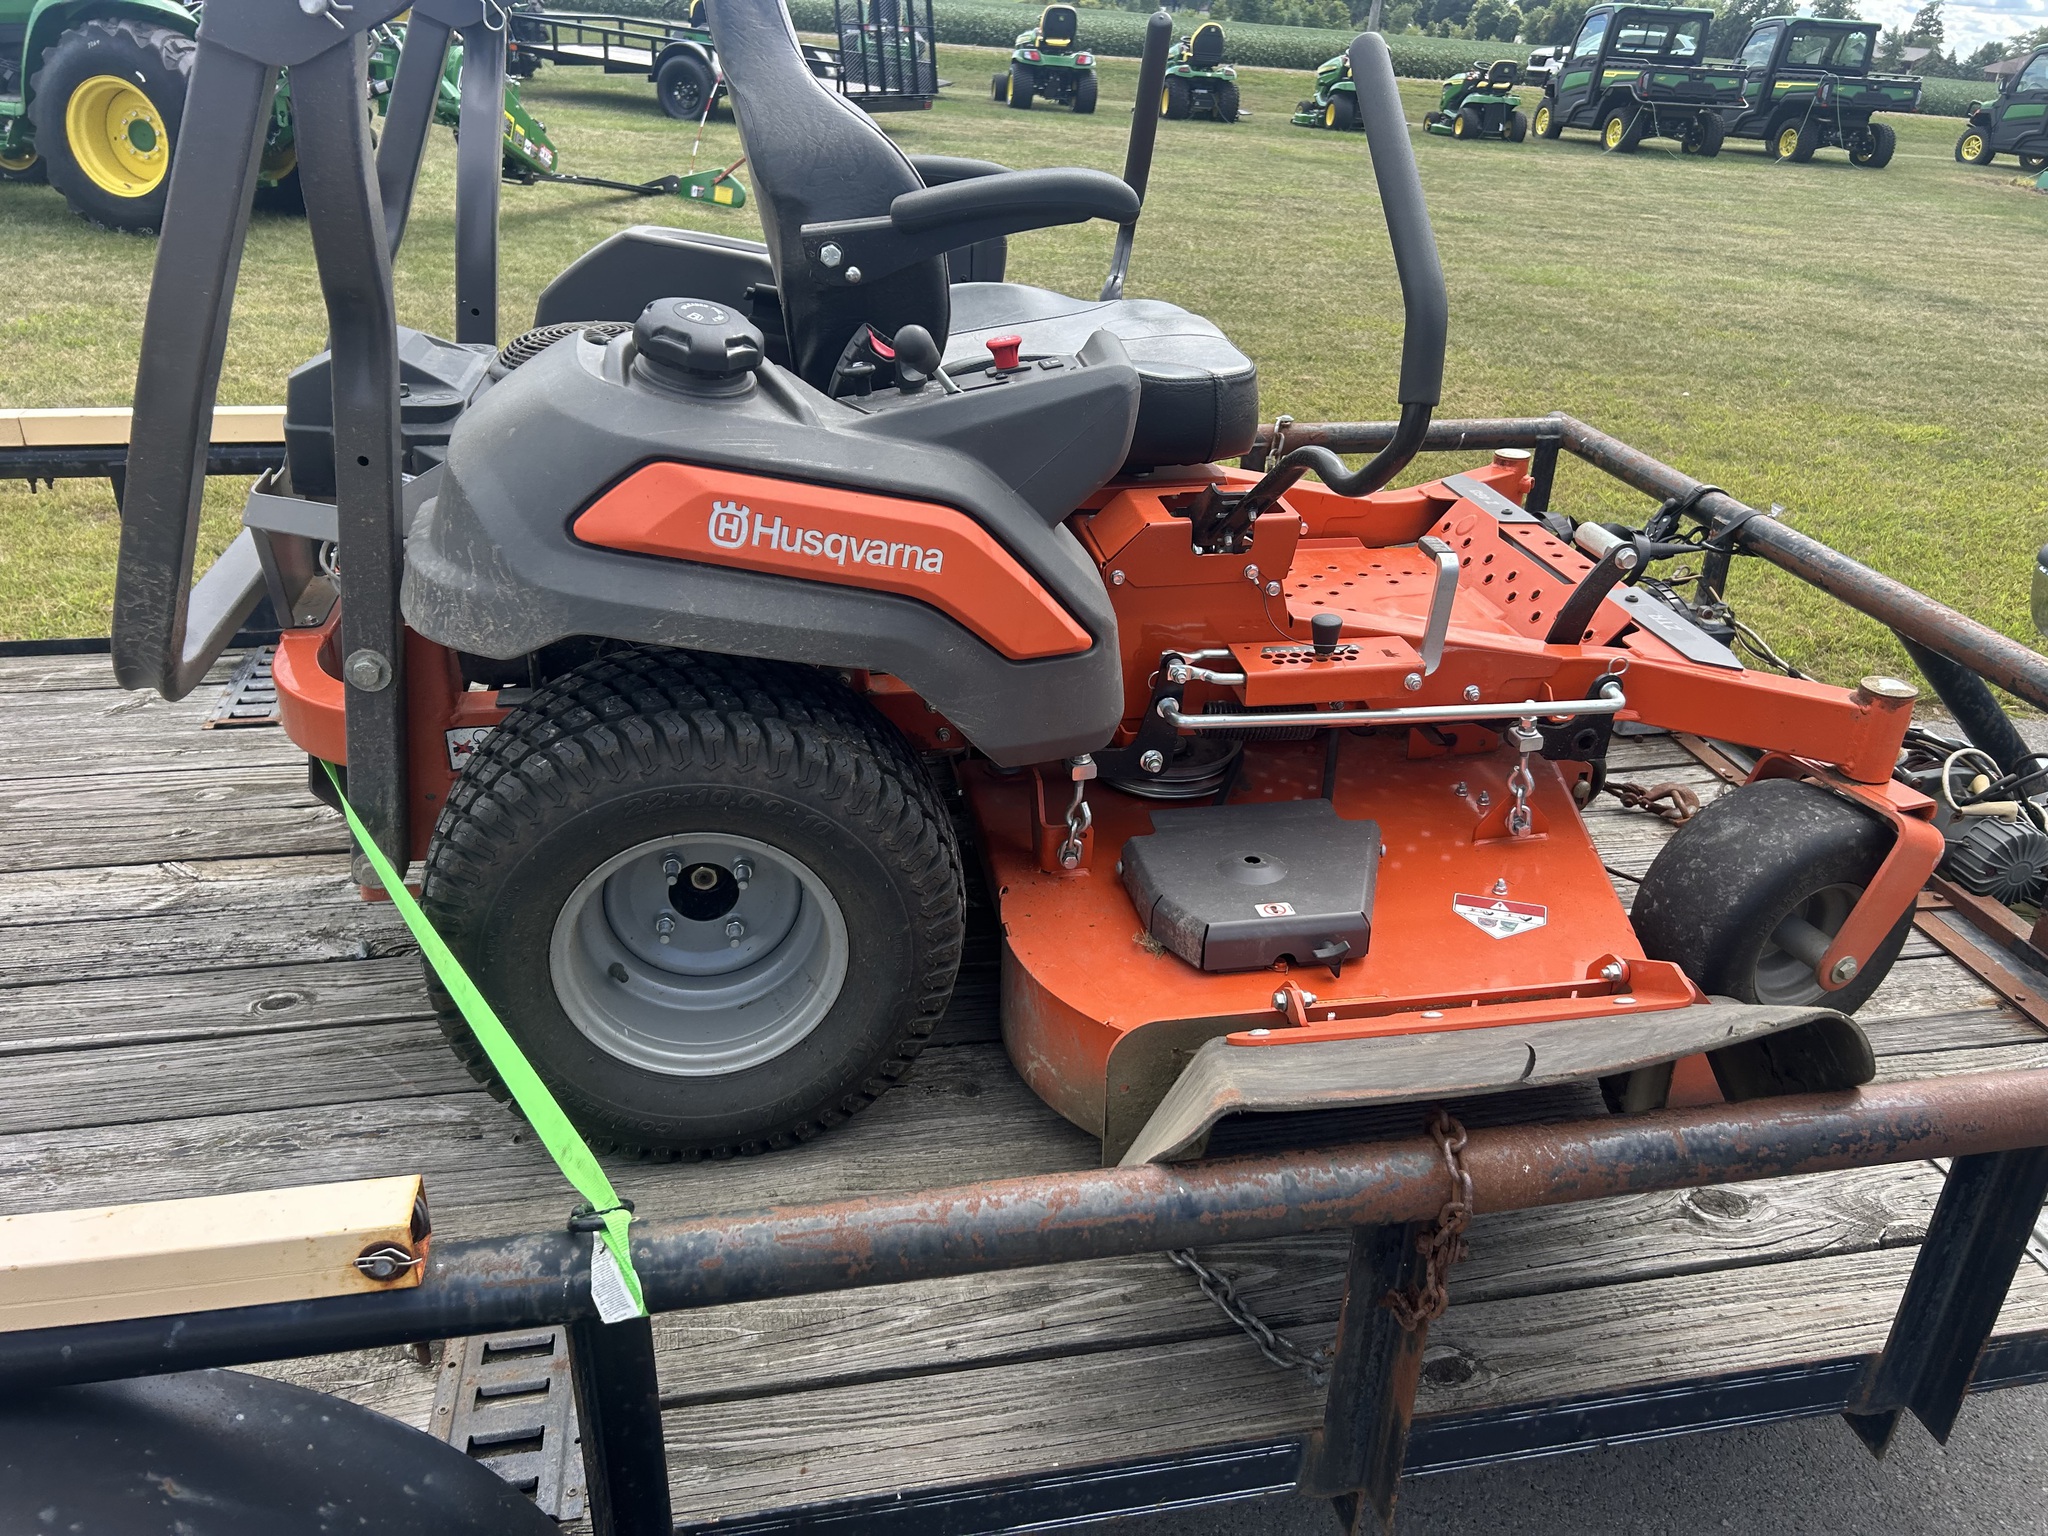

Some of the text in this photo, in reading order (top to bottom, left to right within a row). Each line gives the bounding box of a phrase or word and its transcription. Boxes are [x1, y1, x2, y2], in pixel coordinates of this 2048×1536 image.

[751, 513, 944, 574] Husqvarna
[1648, 613, 1684, 631] ZTR
[758, 1033, 880, 1126] KENDA
